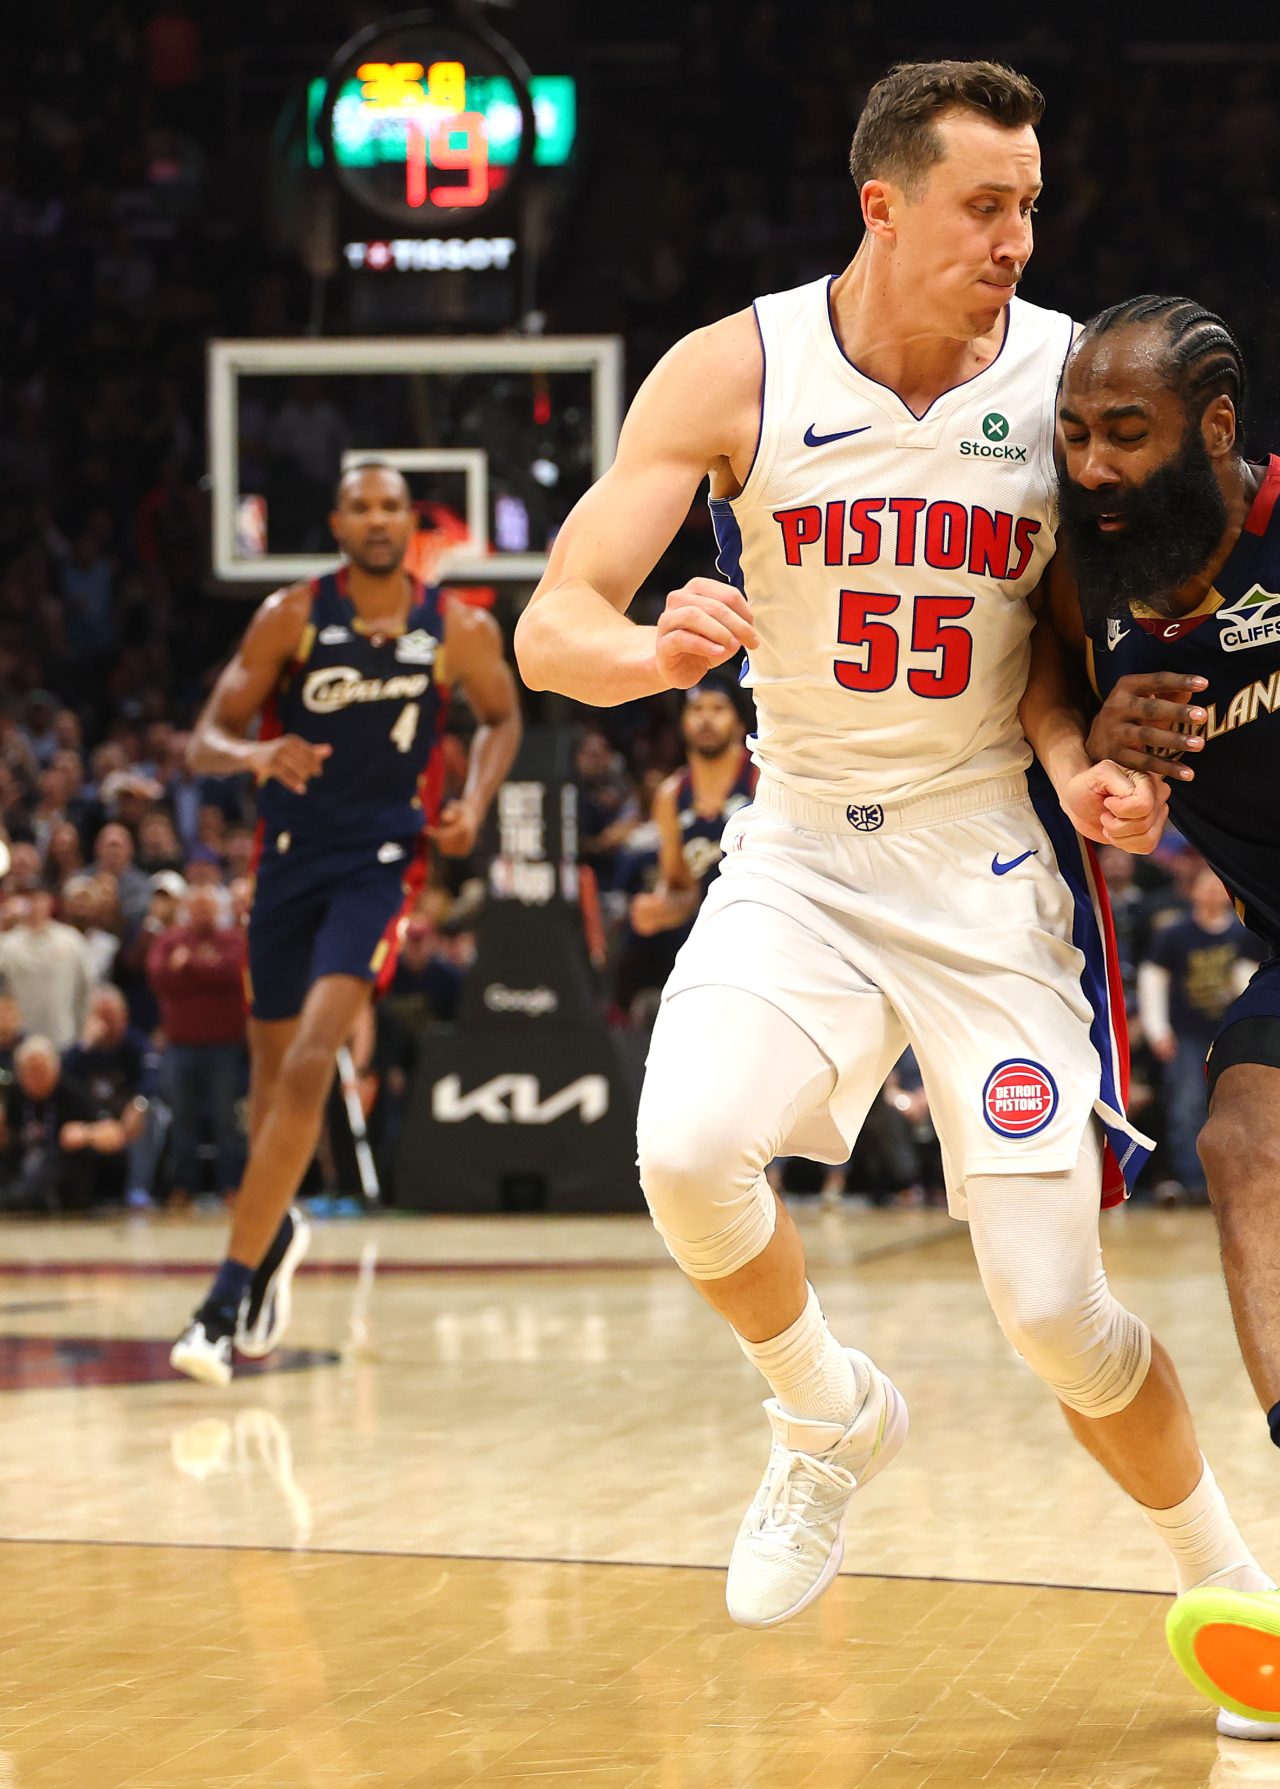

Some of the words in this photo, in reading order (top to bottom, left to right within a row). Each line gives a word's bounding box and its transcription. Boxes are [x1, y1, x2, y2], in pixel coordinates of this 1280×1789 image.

[406, 112, 488, 207] 19
[960, 441, 1027, 462] StockX
[772, 497, 1041, 580] PISTONS
[833, 589, 975, 699] 55
[390, 701, 420, 753] 4
[995, 1084, 1042, 1099] DETROIT
[995, 1098, 1043, 1113] PISTONS
